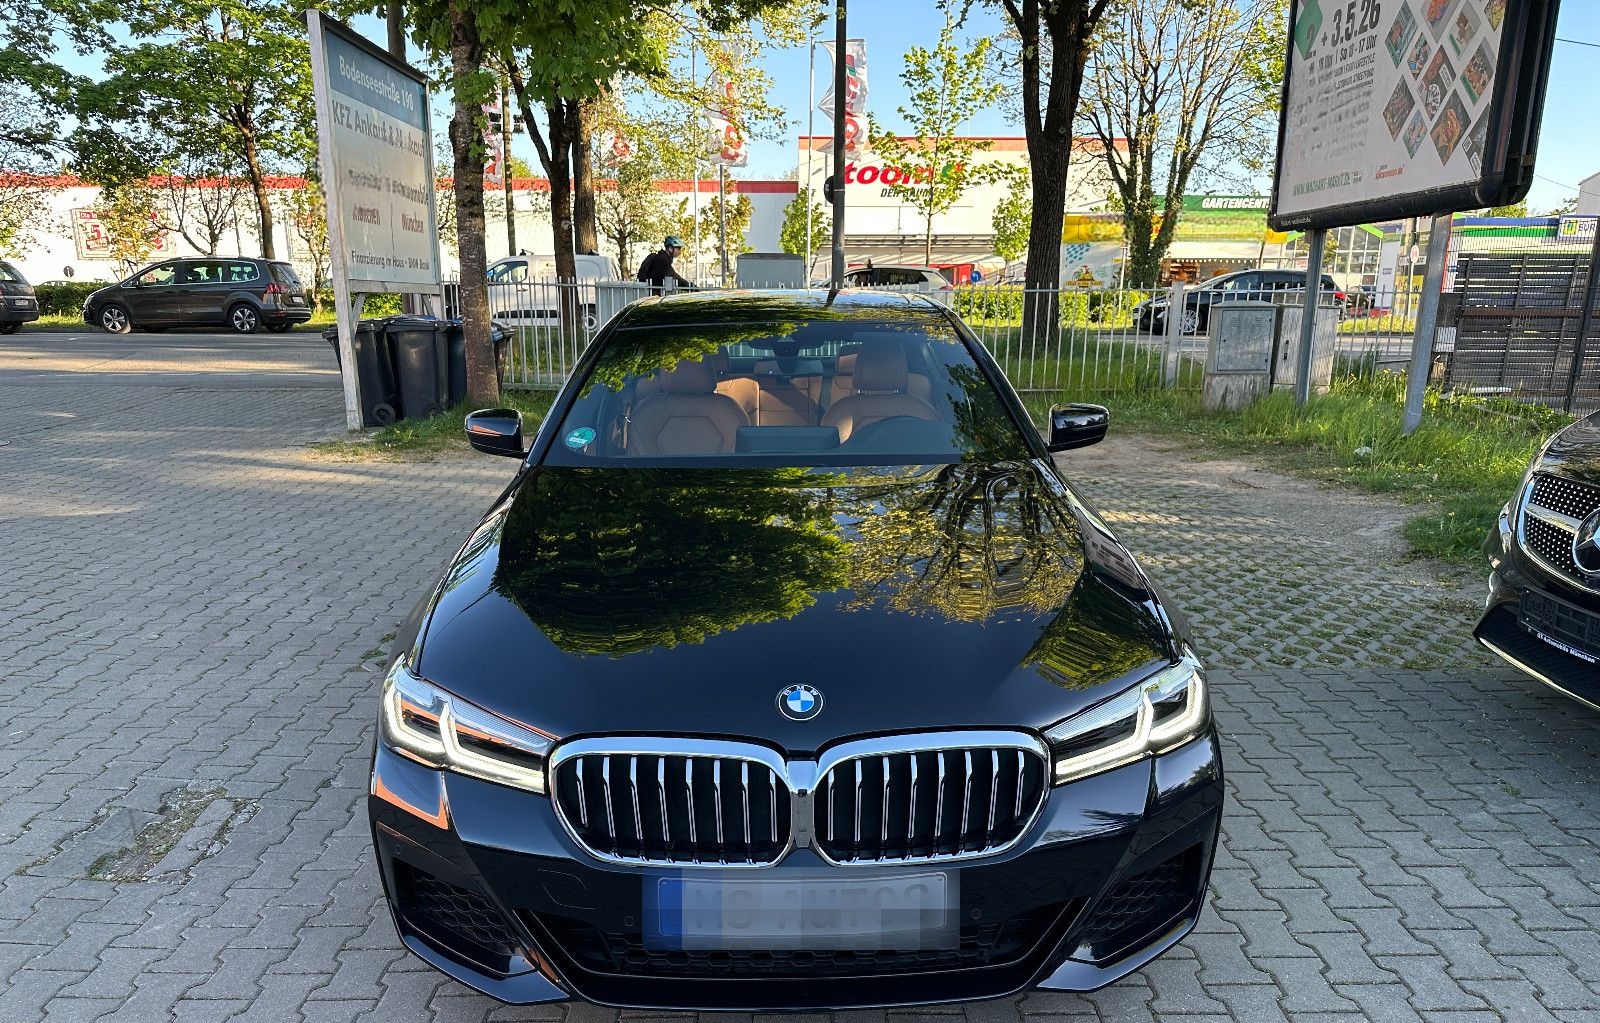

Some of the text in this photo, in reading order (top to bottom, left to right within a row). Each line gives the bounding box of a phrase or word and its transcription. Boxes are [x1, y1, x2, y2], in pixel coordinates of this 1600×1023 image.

[338, 54, 414, 111] Bodenseestraße 190
[331, 99, 353, 130] KFZ
[1201, 197, 1271, 209] GARTENCENT
[778, 883, 930, 930] AUTOS
